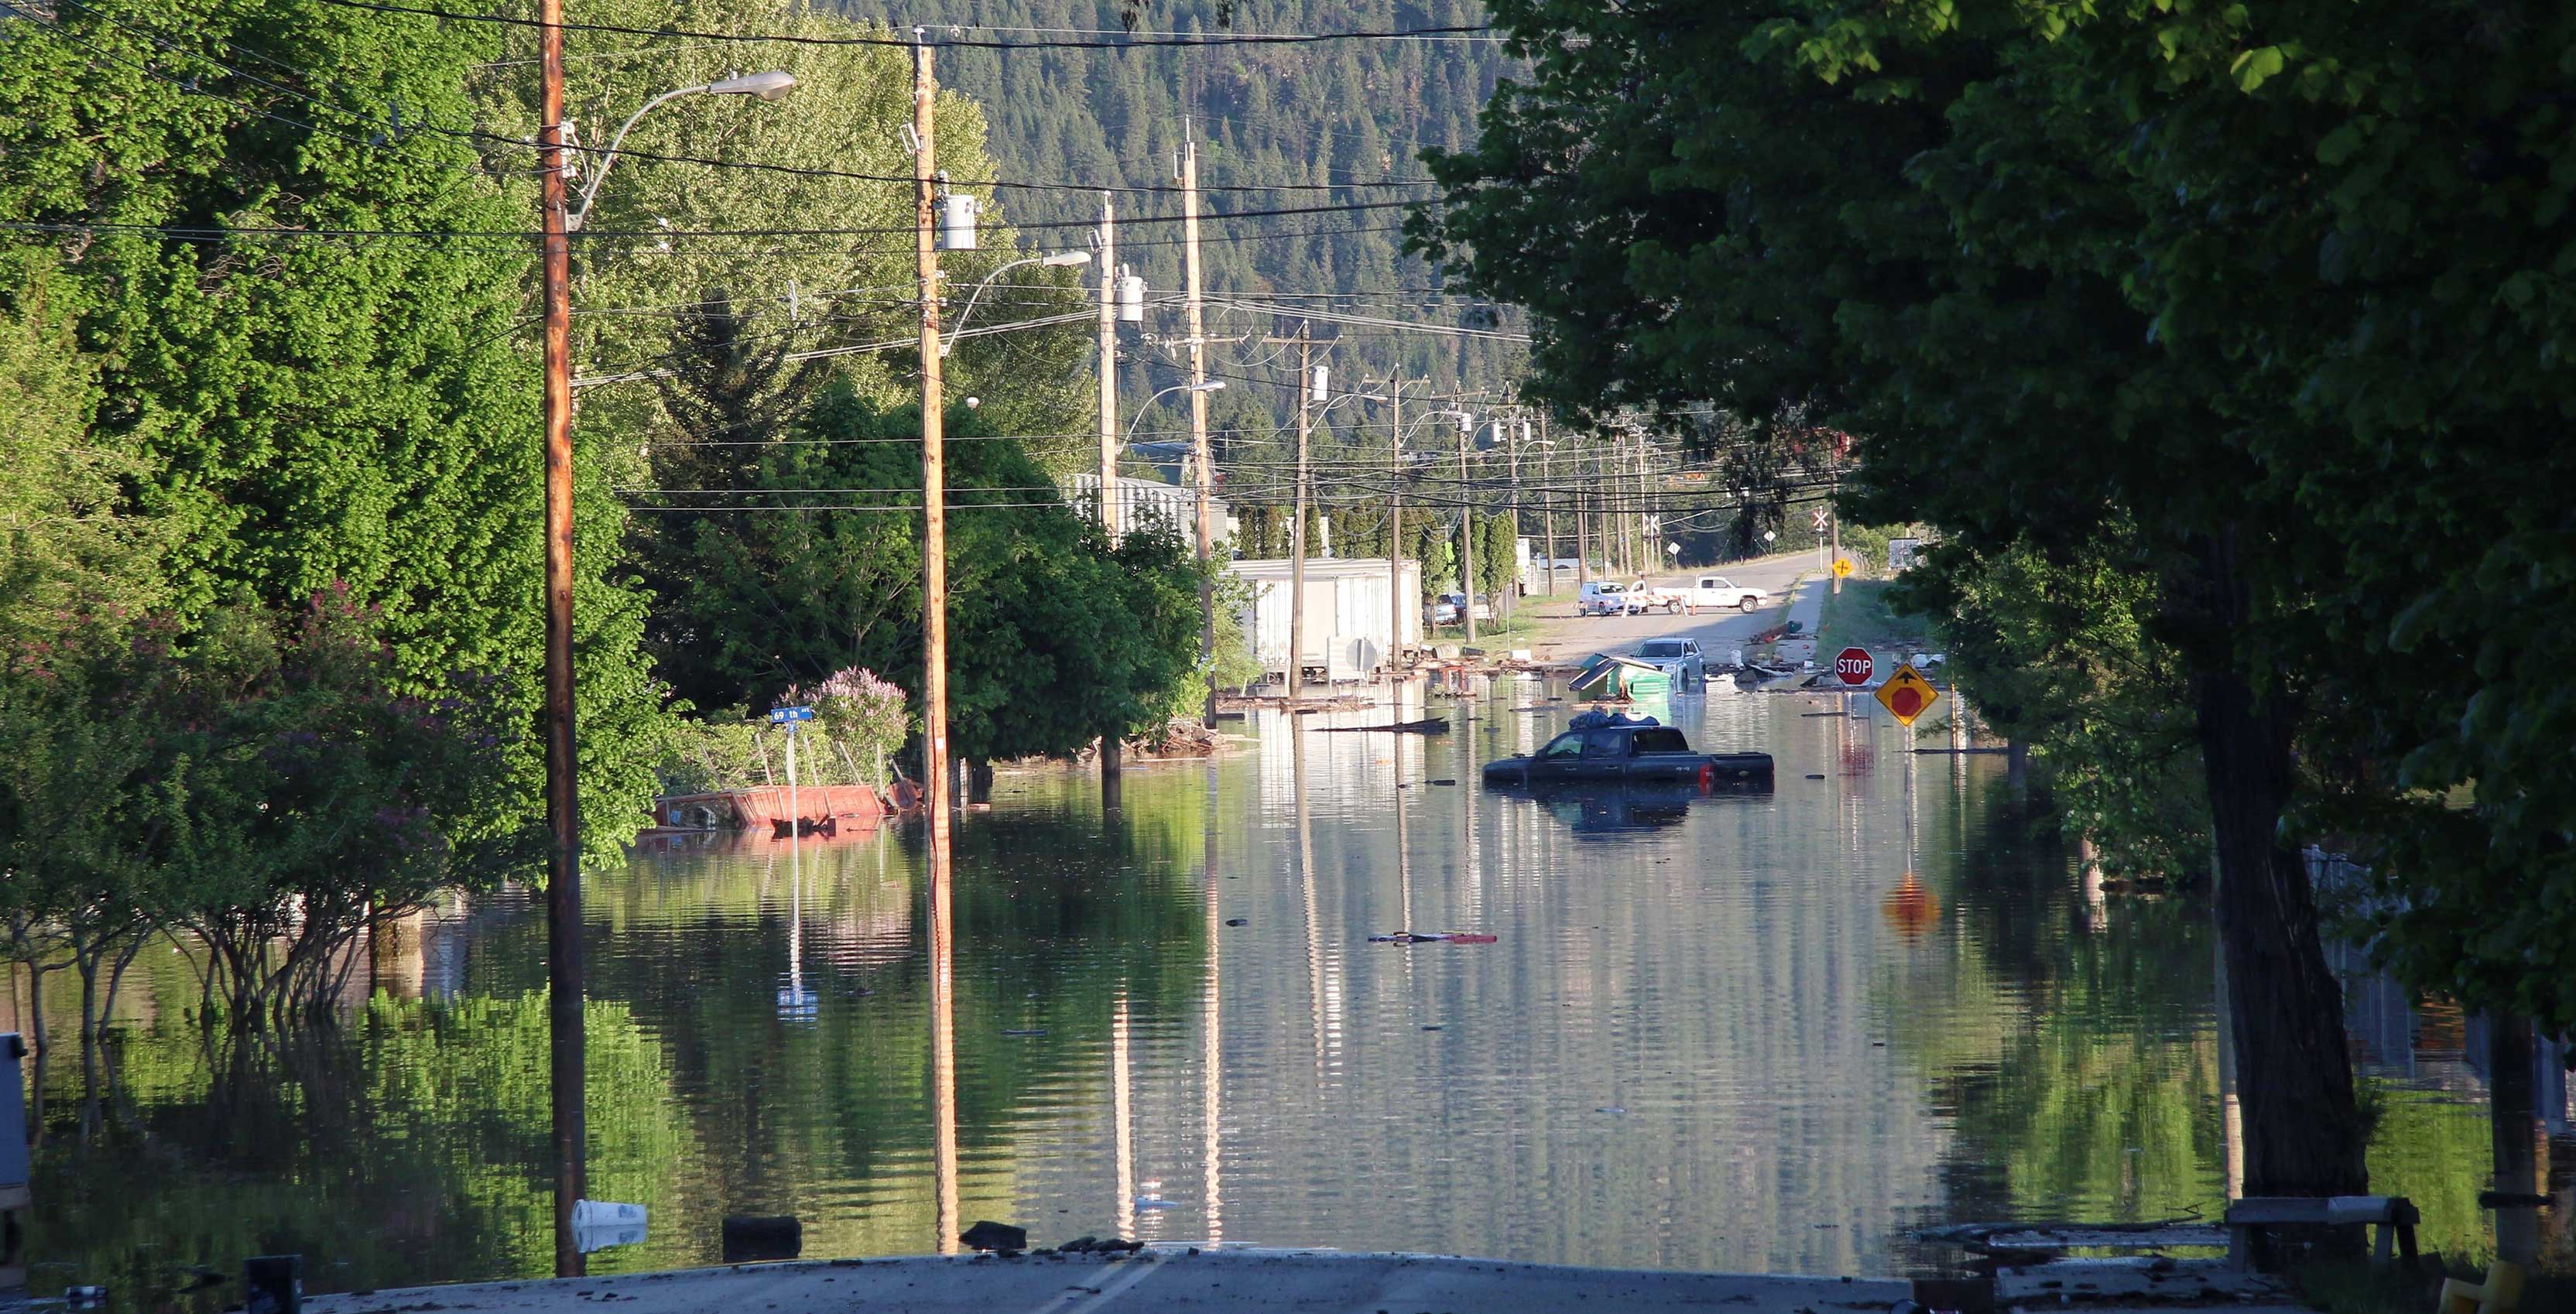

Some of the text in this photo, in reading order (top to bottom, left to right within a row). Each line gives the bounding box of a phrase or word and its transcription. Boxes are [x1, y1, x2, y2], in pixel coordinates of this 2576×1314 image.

[1838, 659, 1872, 674] STOP
[774, 711, 784, 720] 69
[789, 710, 798, 719] th
